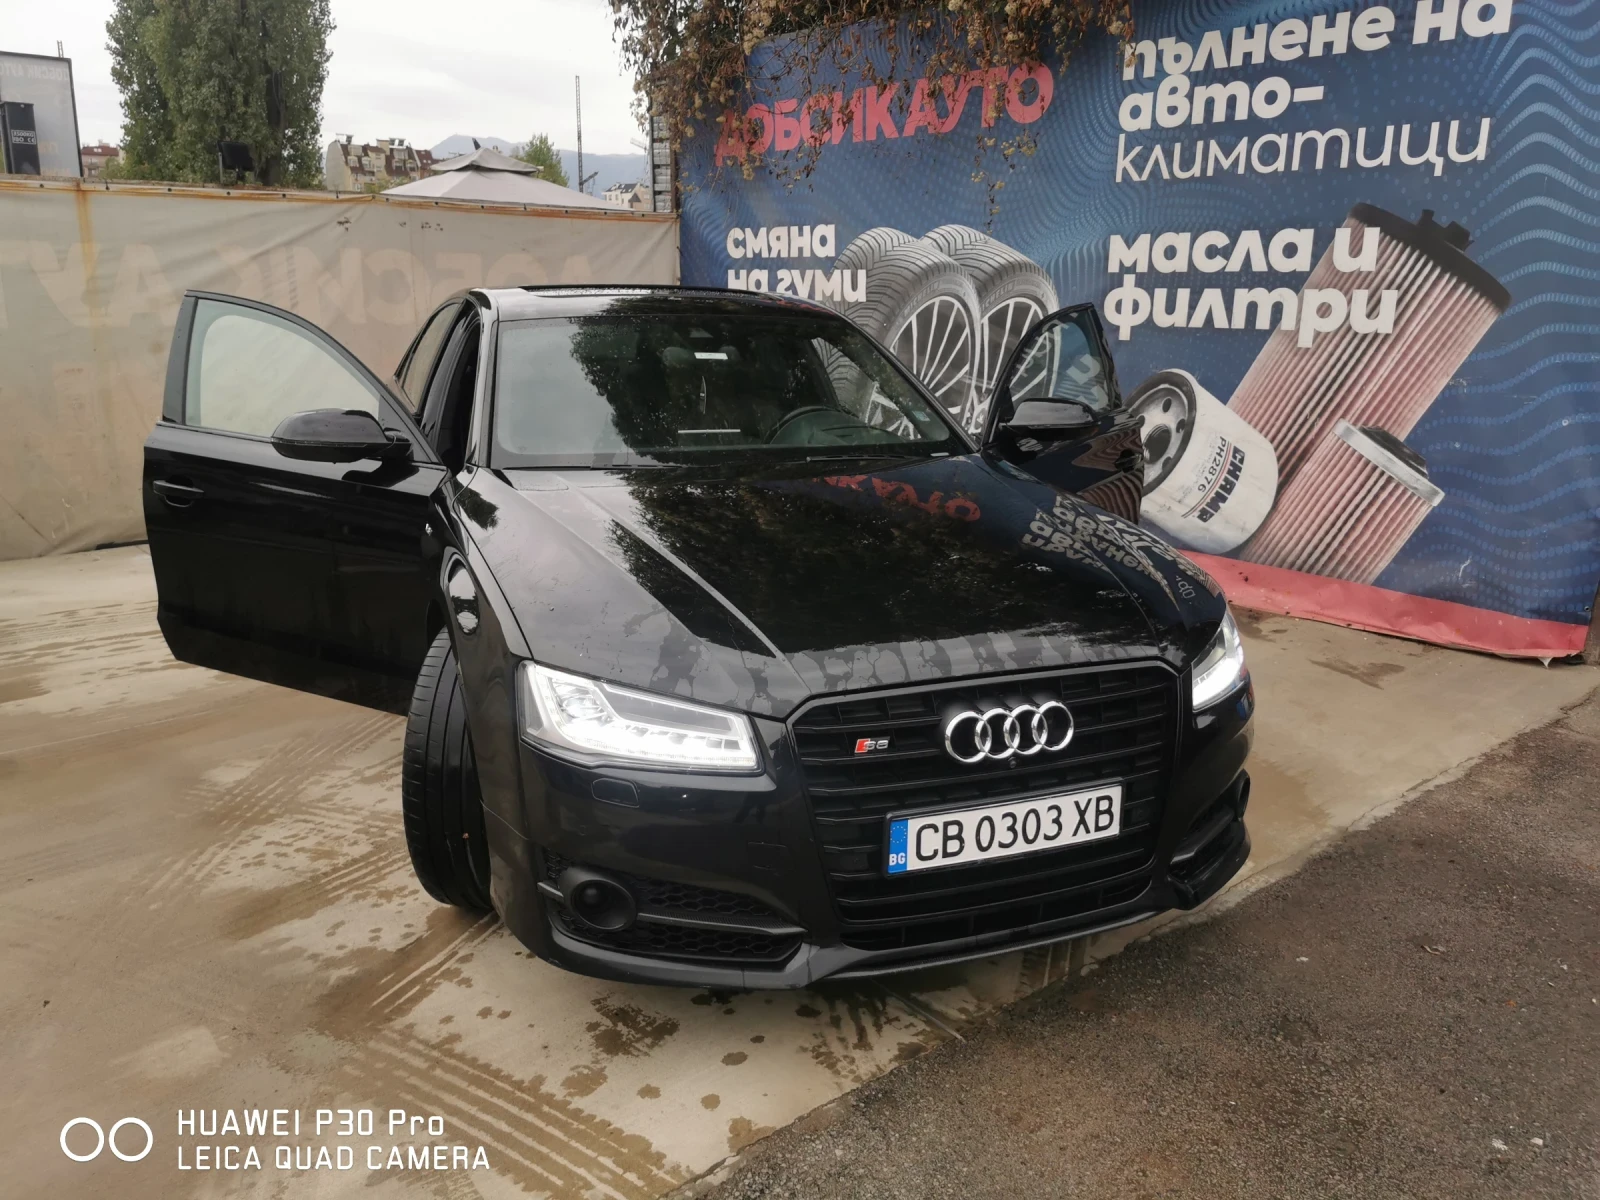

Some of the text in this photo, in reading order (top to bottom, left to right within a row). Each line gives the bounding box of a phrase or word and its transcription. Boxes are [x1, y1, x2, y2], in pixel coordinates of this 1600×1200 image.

[1122, 0, 1515, 81] пълнене на
[902, 62, 1054, 137] АУТО
[1118, 74, 1325, 132] авто-
[1115, 117, 1491, 182] климатици
[726, 224, 836, 259] смяна
[1107, 226, 1381, 274] масла и
[727, 268, 867, 303] на гуми
[1103, 274, 1399, 348] филтри
[1197, 435, 1227, 493] PH2876
[915, 794, 1115, 863] CB 0303 XB
[888, 852, 906, 866] BG
